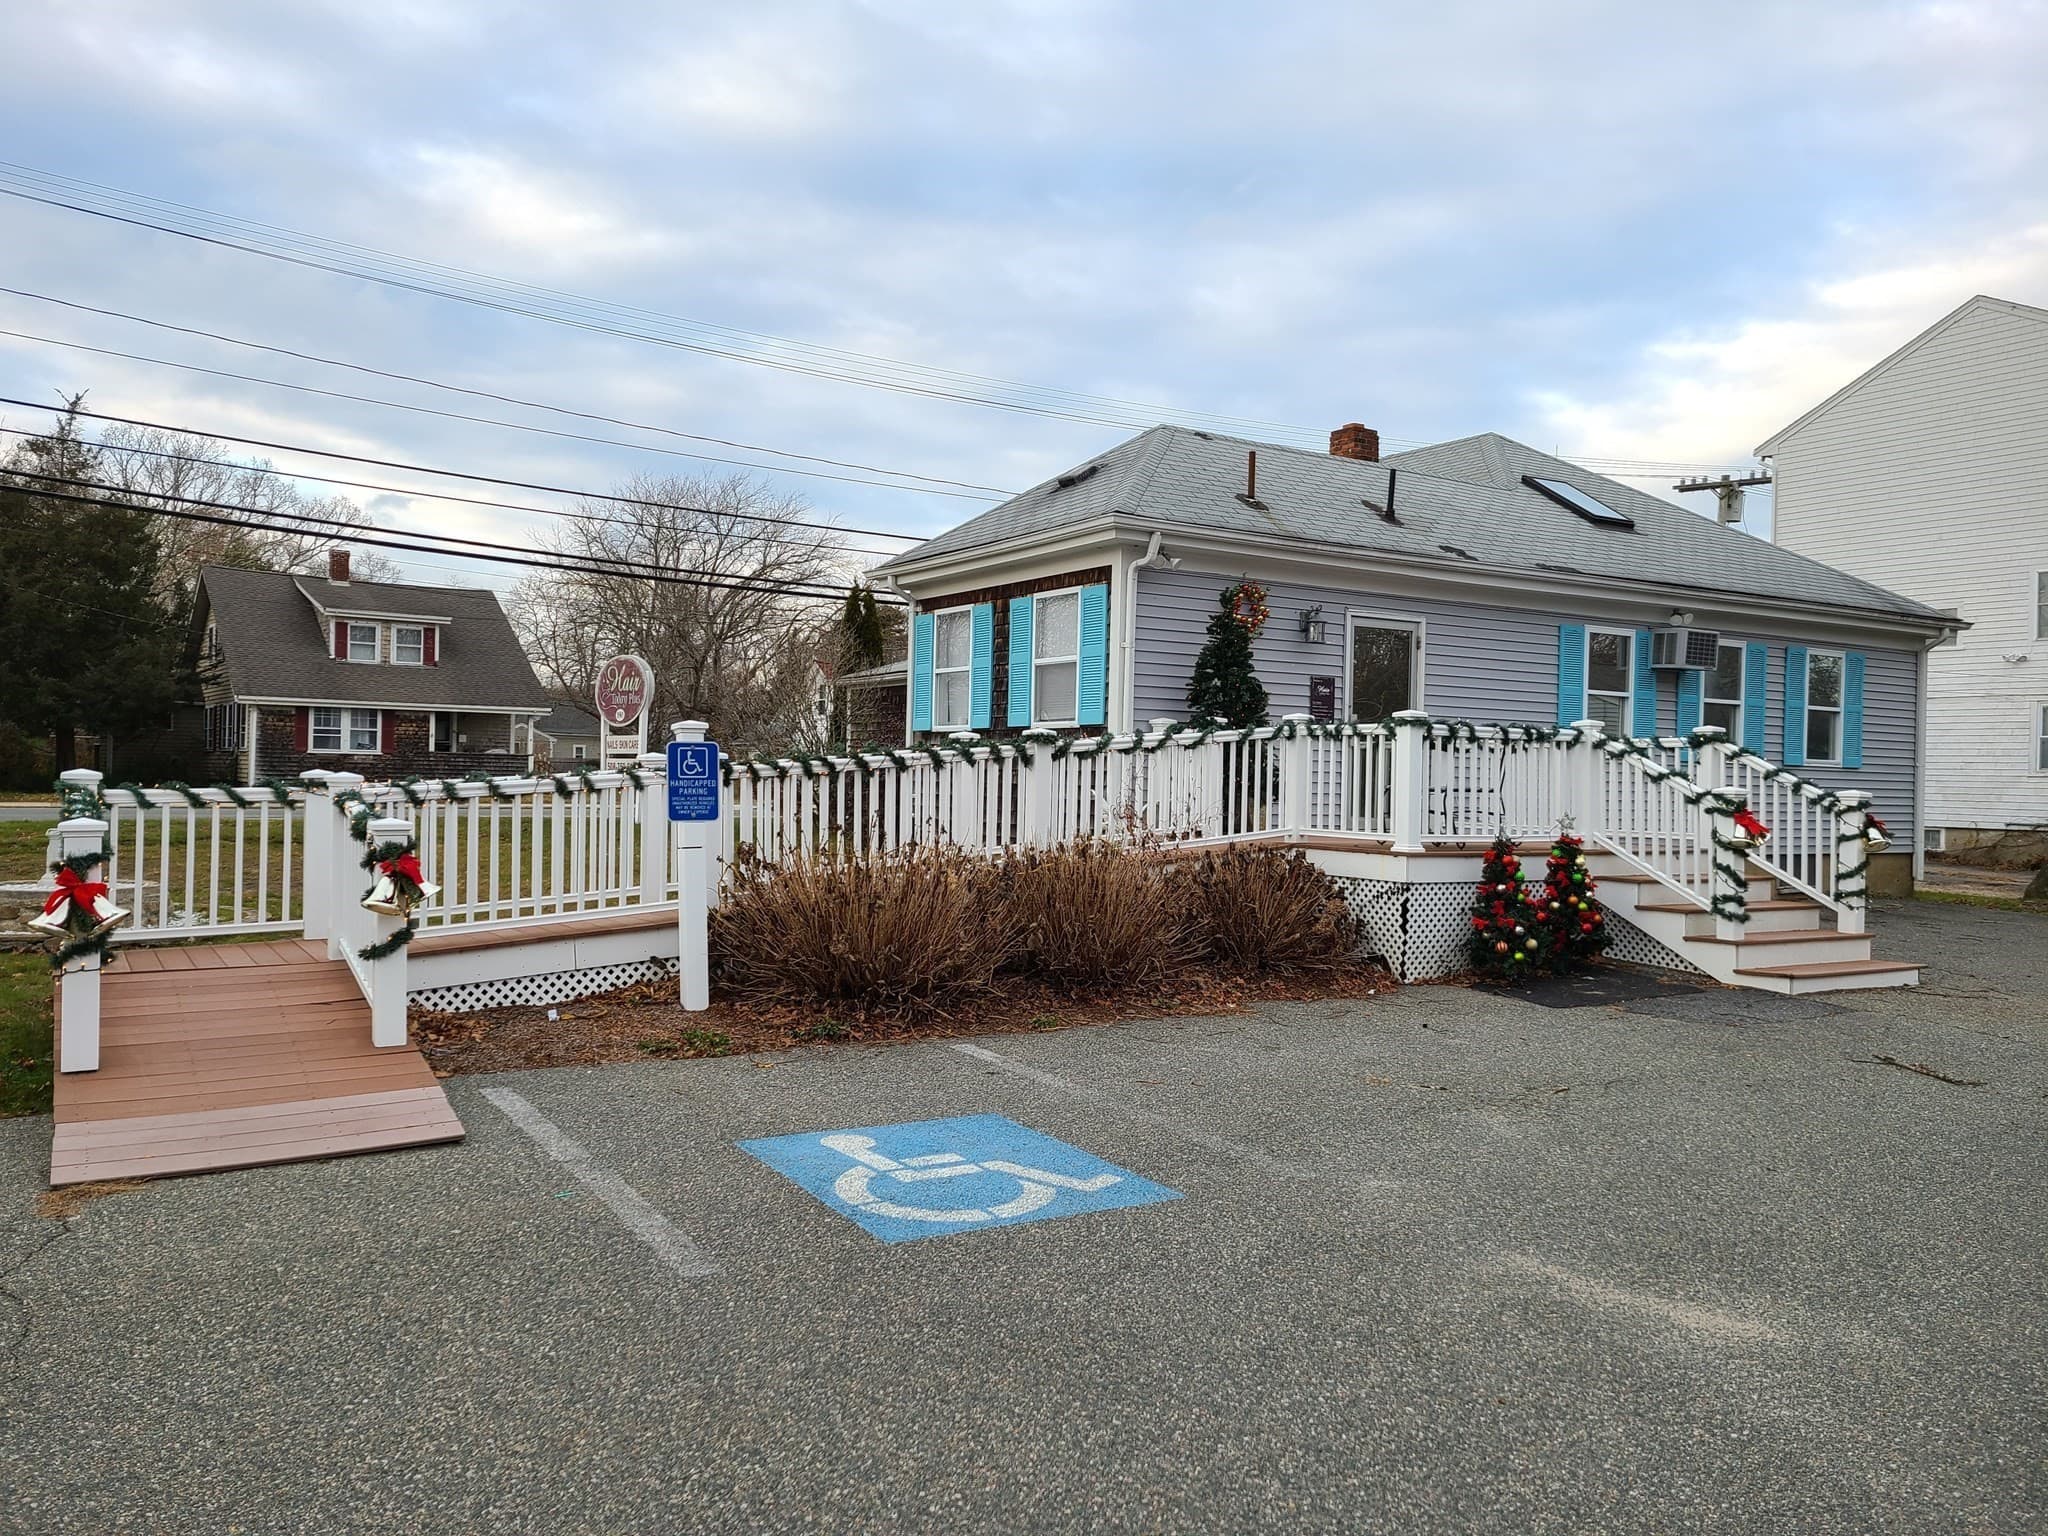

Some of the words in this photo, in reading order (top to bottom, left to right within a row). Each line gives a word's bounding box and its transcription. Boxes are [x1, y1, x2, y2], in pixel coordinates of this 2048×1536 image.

[608, 664, 641, 692] Hair
[619, 740, 628, 749] SKIN
[629, 740, 639, 749] CARE
[670, 779, 716, 787] HANDICAPPED
[679, 787, 708, 795] PARKING
